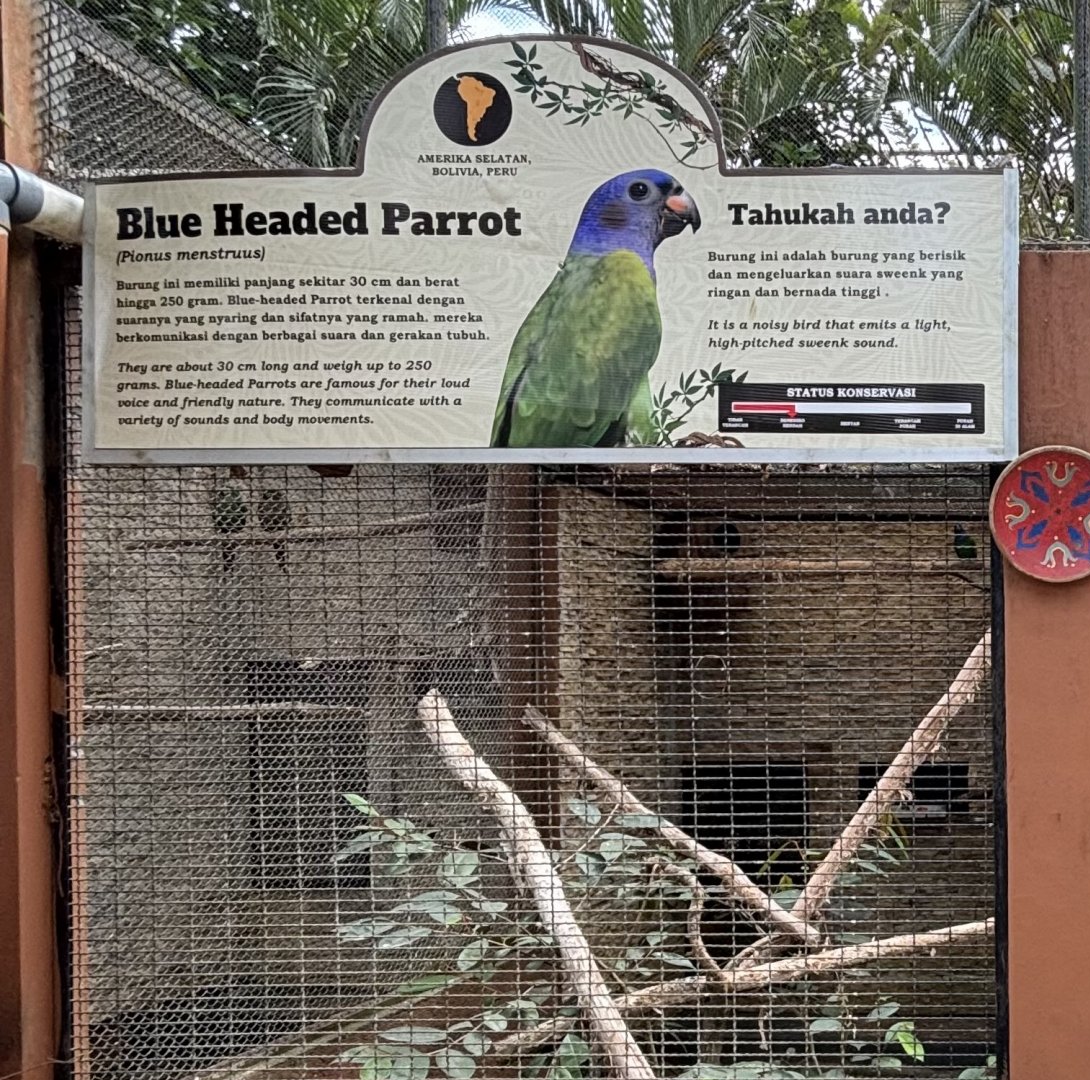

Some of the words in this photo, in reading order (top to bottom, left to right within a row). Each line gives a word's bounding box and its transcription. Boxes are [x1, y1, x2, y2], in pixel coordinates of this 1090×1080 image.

[417, 154, 472, 164] AMERIKA
[475, 154, 532, 165] SELATAN,
[432, 167, 483, 177] BOLIVIA,
[486, 167, 518, 177] PERU
[116, 206, 203, 241] Blue
[212, 202, 369, 237] Headed
[381, 202, 522, 237] Parrot
[727, 202, 855, 226] Tahukah
[863, 202, 951, 225] anda?
[115, 249, 172, 266] (Pionus
[176, 246, 266, 262] menstruus)
[707, 251, 756, 264] Burung
[760, 250, 779, 262] ini
[782, 250, 827, 261] adalah
[830, 249, 879, 264] burung
[882, 252, 915, 264] yang
[919, 249, 966, 261] berisik
[707, 269, 732, 280] dan
[736, 268, 832, 282] mengeluarkan
[836, 270, 873, 279] suara
[876, 267, 927, 279] sweenk
[931, 270, 964, 282] yang
[115, 279, 161, 293] Burung
[163, 278, 181, 289] ini
[183, 276, 241, 289] memiliki
[244, 276, 296, 290] panjang
[299, 276, 346, 287] sekitar
[349, 276, 367, 287] 30
[371, 278, 392, 287] cm
[396, 276, 421, 287] dan
[424, 276, 460, 287] berat
[707, 287, 751, 300] ringan
[755, 286, 780, 297] dan
[783, 286, 837, 297] bernada
[115, 297, 157, 311] hingga
[159, 295, 184, 307] 250
[187, 297, 223, 309] gram.
[227, 293, 307, 306] Blue-headed
[310, 294, 352, 305] Parrot
[356, 294, 413, 305] terkenal
[416, 294, 465, 308] dengan
[115, 316, 172, 328] suaranya
[174, 315, 205, 327] yang
[208, 312, 258, 326] nyaring
[261, 312, 285, 323] dan
[288, 311, 343, 325] sifatnya
[345, 314, 379, 325] yang
[382, 311, 429, 323] ramah.
[433, 312, 483, 323] mereka
[707, 319, 719, 330] It
[723, 319, 735, 330] is
[739, 322, 748, 330] a
[752, 319, 789, 333] noisy
[793, 319, 821, 330] bird
[825, 319, 855, 330] that
[858, 319, 897, 330] emits
[900, 322, 910, 330] a
[915, 319, 951, 333] light,
[114, 330, 209, 343] berkomunikasi
[211, 330, 259, 344] dengan
[261, 329, 317, 344] berbagai
[320, 332, 357, 341] suara
[360, 329, 385, 340] dan
[389, 329, 442, 343] gerakan
[446, 330, 490, 340] tubuh.
[708, 337, 795, 351] high-pitched
[798, 337, 849, 348] sweenk
[853, 337, 898, 348] sound.
[786, 387, 834, 398] STATUS
[837, 387, 916, 398] KONSERVASI
